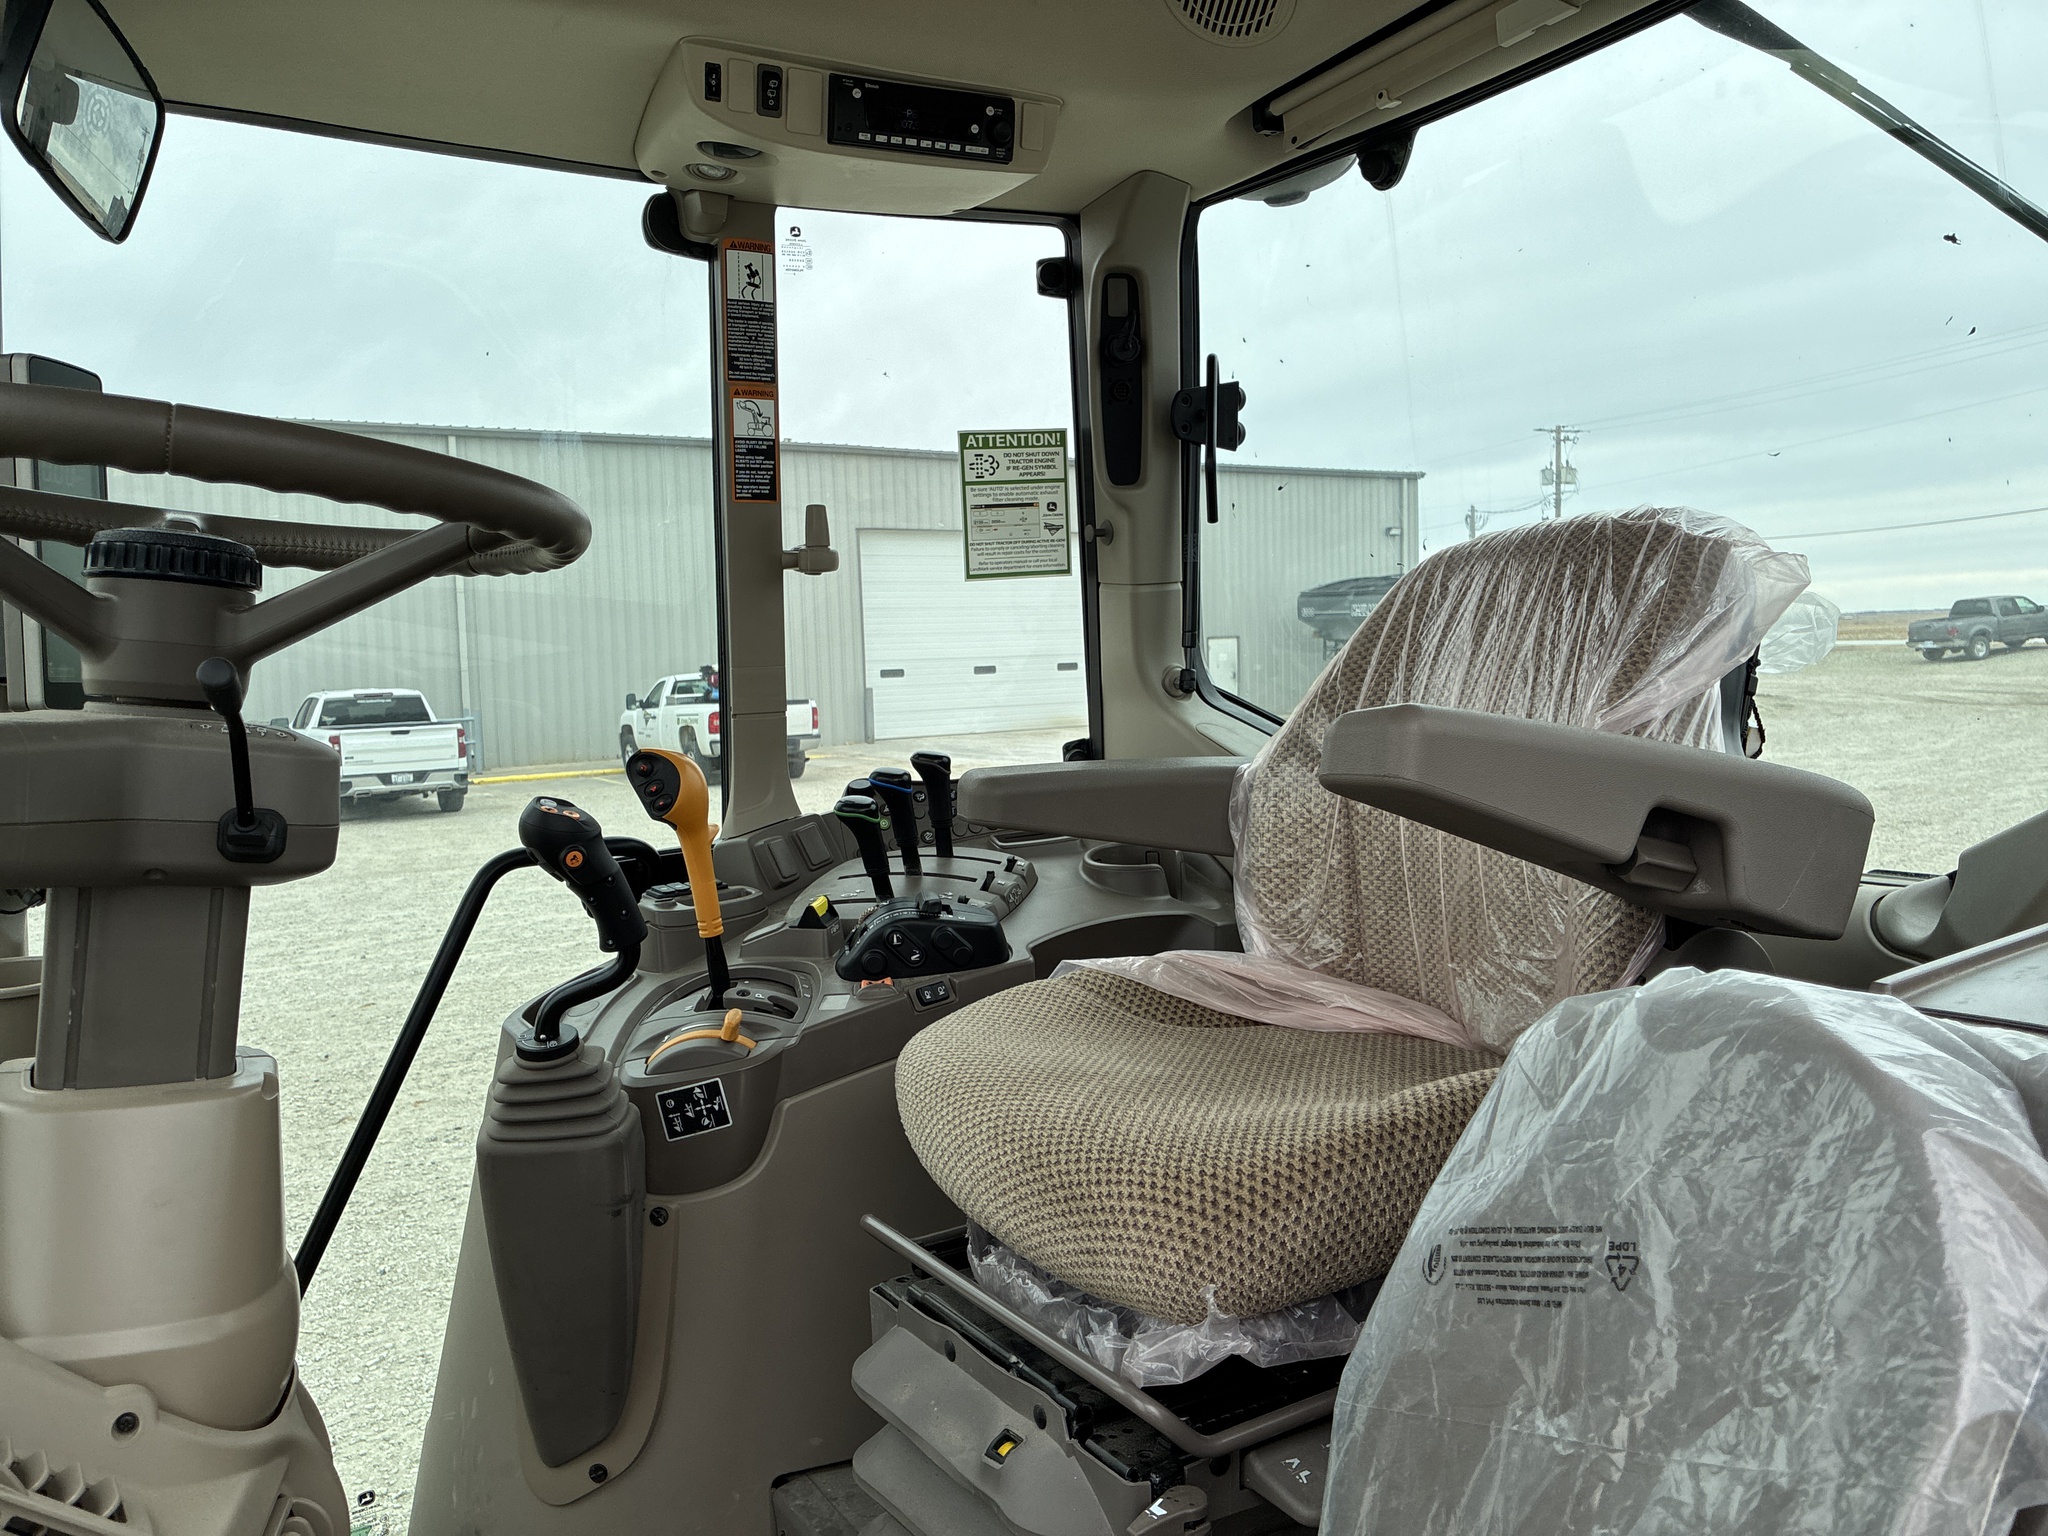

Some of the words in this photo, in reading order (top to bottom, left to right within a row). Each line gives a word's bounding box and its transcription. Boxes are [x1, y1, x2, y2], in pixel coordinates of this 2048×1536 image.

[738, 241, 771, 252] WARNING
[741, 389, 774, 397] WARNING
[966, 433, 1060, 448] ATTENTION!
[1608, 1242, 1636, 1251] LDPE
[1618, 1264, 1626, 1278] 4
